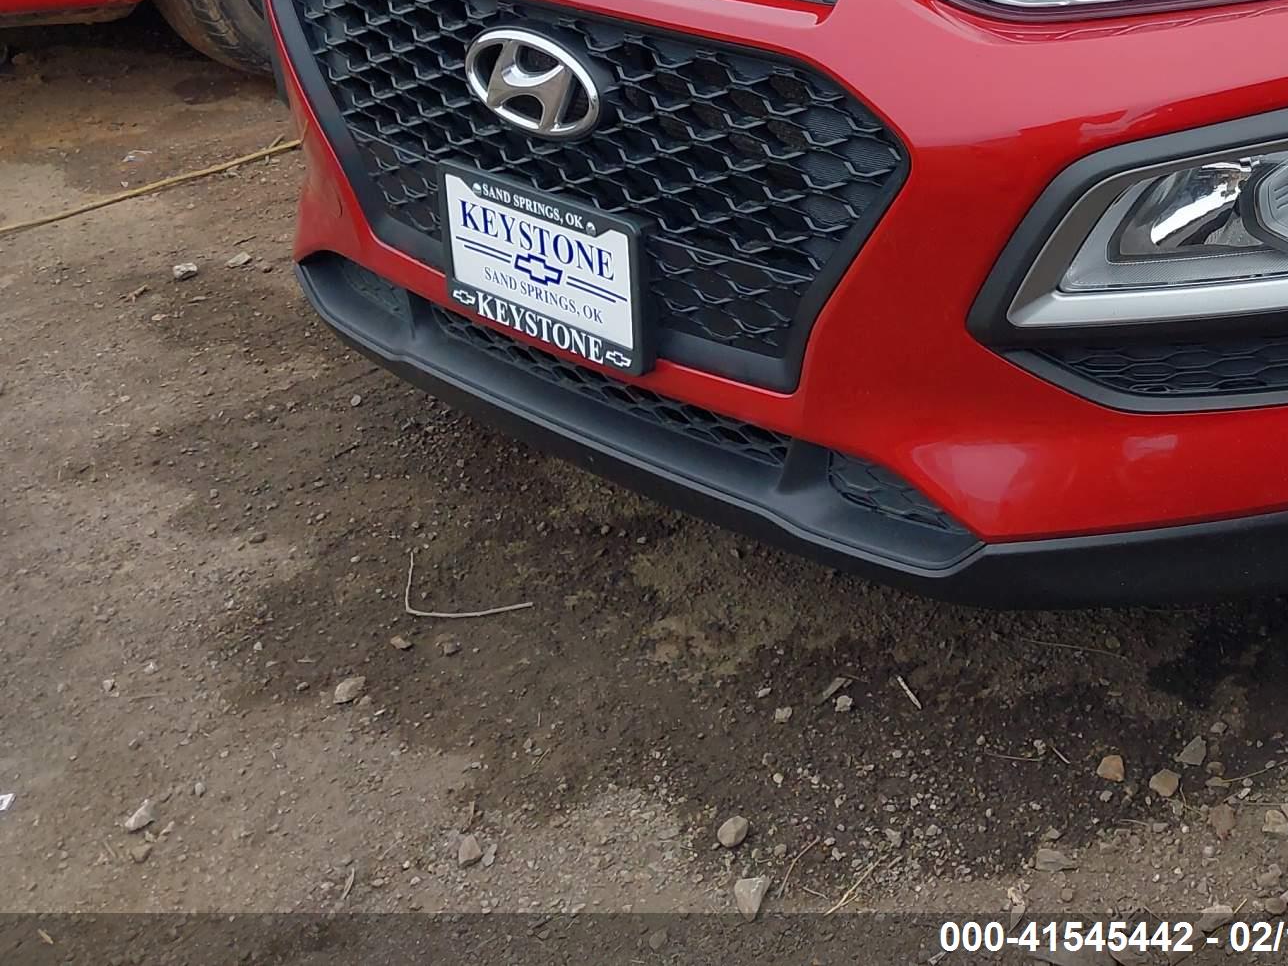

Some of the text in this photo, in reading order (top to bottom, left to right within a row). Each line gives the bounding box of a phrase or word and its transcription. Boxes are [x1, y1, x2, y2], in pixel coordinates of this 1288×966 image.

[482, 183, 583, 229] SAND SPRINGS, OK
[458, 198, 615, 282] KEYSTONE
[475, 290, 605, 365] KEYSTONE
[484, 266, 604, 325] SAND SPRINGS, OK
